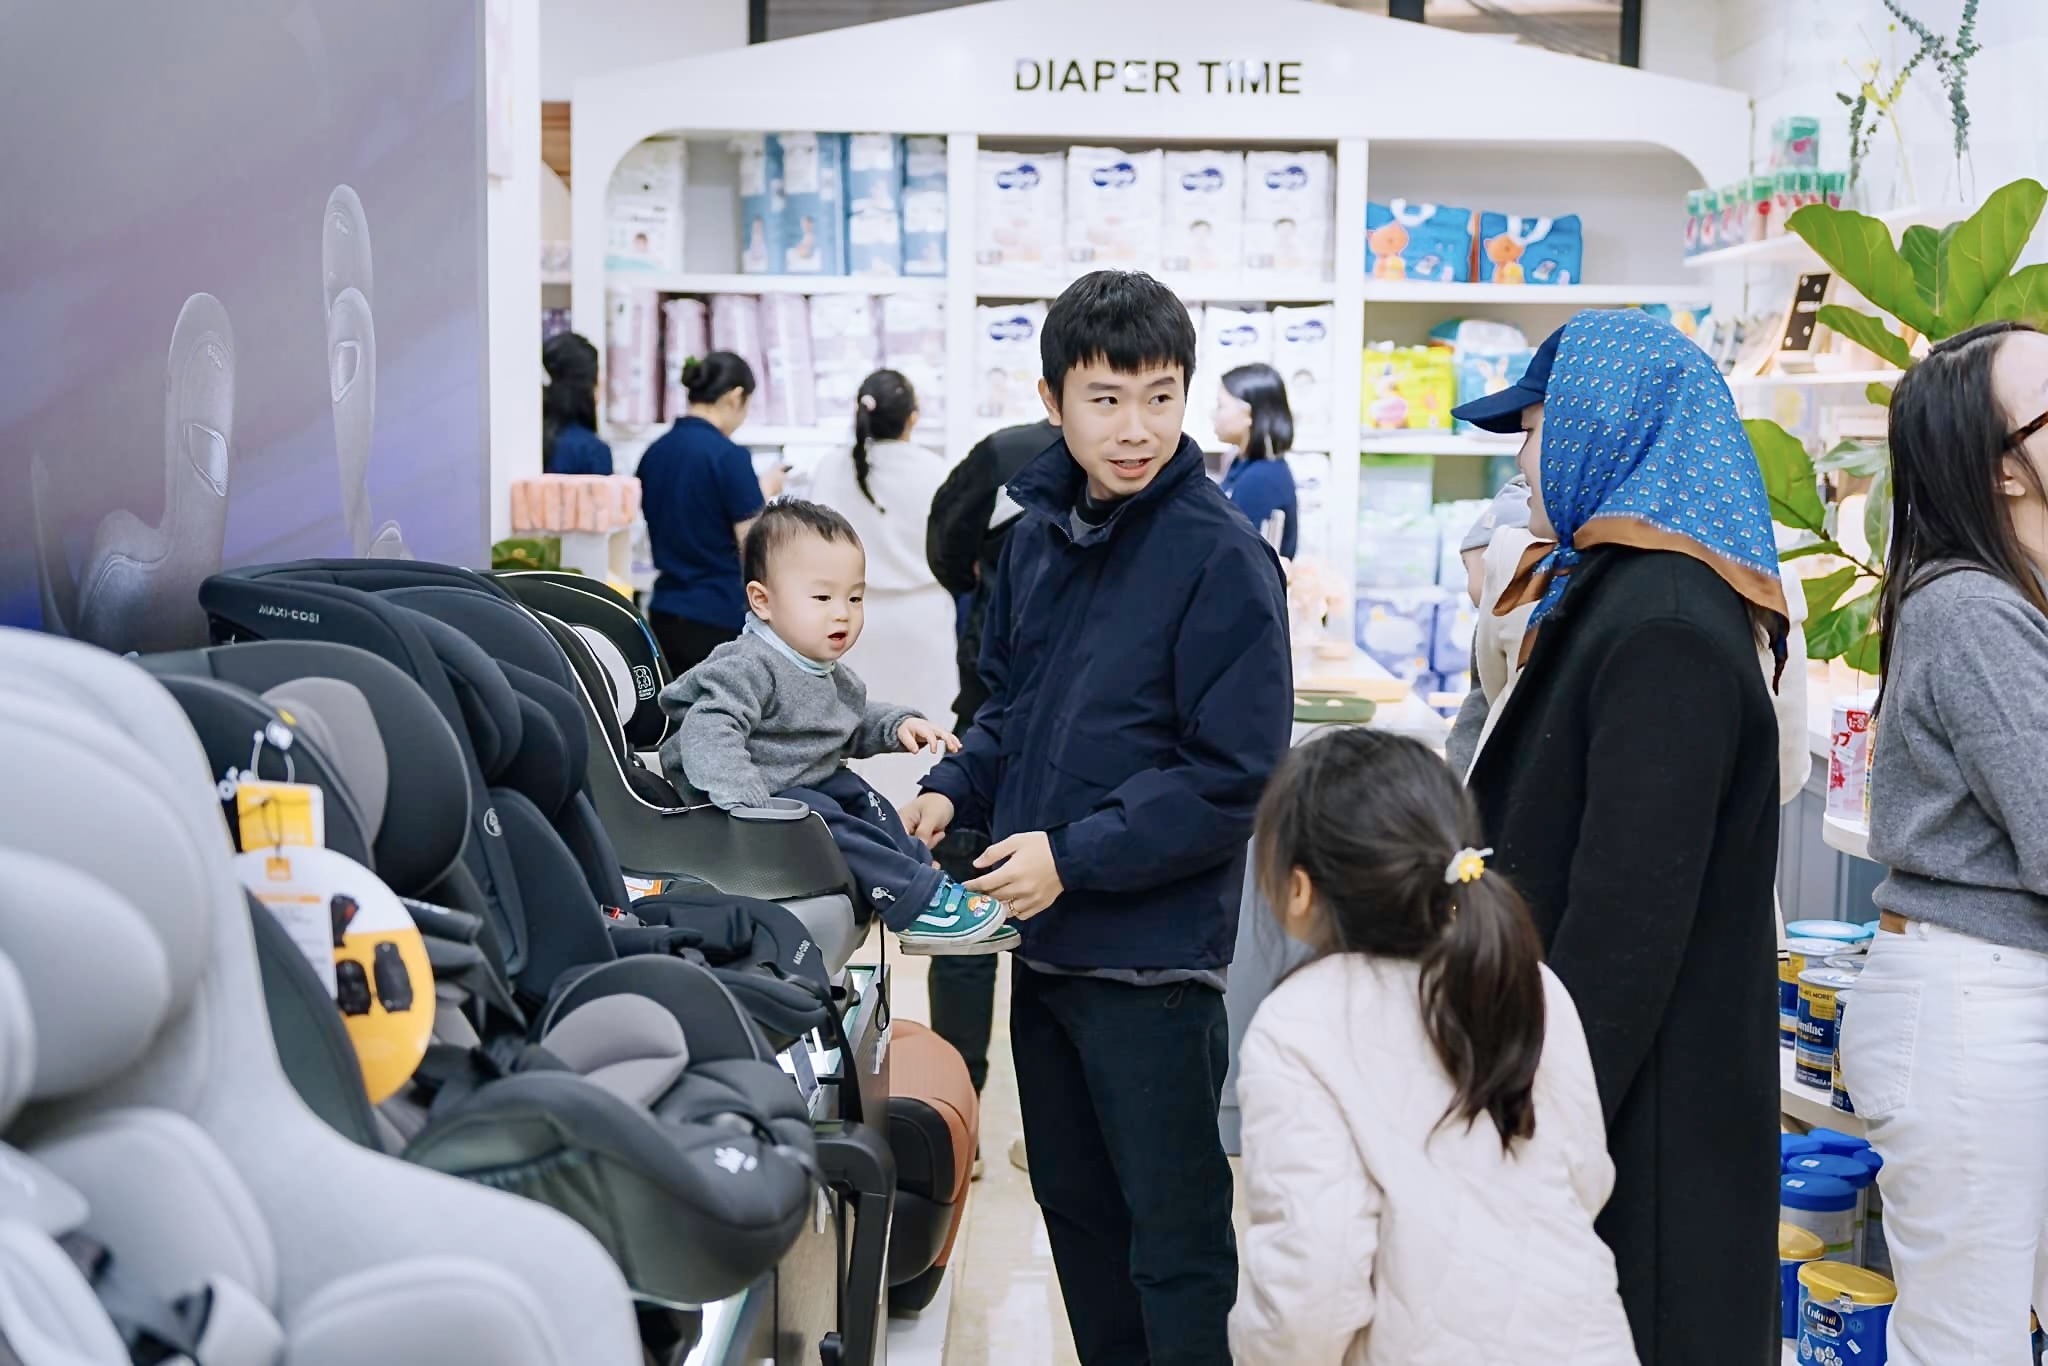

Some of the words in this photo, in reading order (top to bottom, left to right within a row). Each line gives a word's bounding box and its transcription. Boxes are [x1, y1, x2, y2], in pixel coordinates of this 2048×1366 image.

[1015, 58, 1180, 93] DIAPER
[1197, 60, 1302, 94] TIME
[258, 603, 320, 624] MAXI-COSI
[1797, 1021, 1825, 1037] milac
